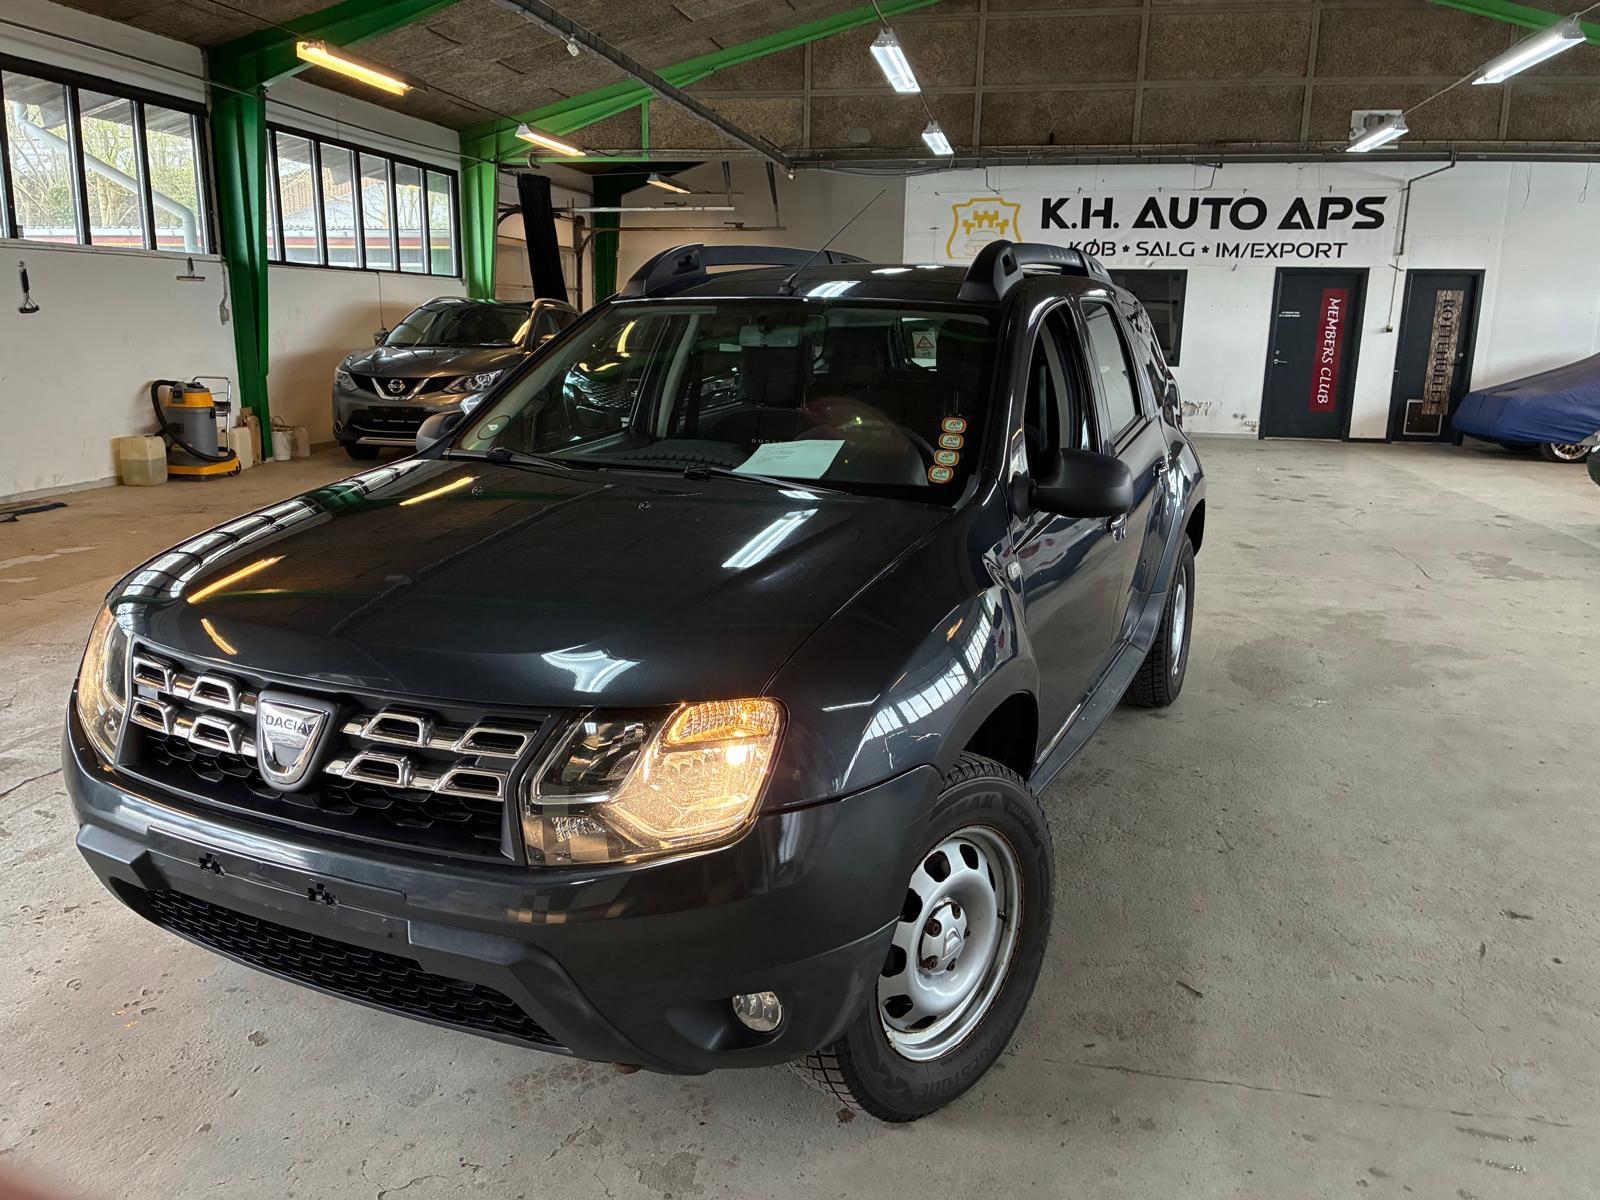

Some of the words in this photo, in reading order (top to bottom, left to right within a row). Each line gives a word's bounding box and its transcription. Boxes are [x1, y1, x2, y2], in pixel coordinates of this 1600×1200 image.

[1041, 197, 1119, 229] K.H.
[1132, 196, 1267, 230] AUTO
[1277, 196, 1388, 230] APS
[1136, 241, 1195, 257] SALG
[1216, 242, 1348, 258] IM/EXPORT
[1321, 297, 1341, 364] MEMBERS
[1317, 367, 1332, 404] CLUB
[265, 714, 309, 736] DACIA
